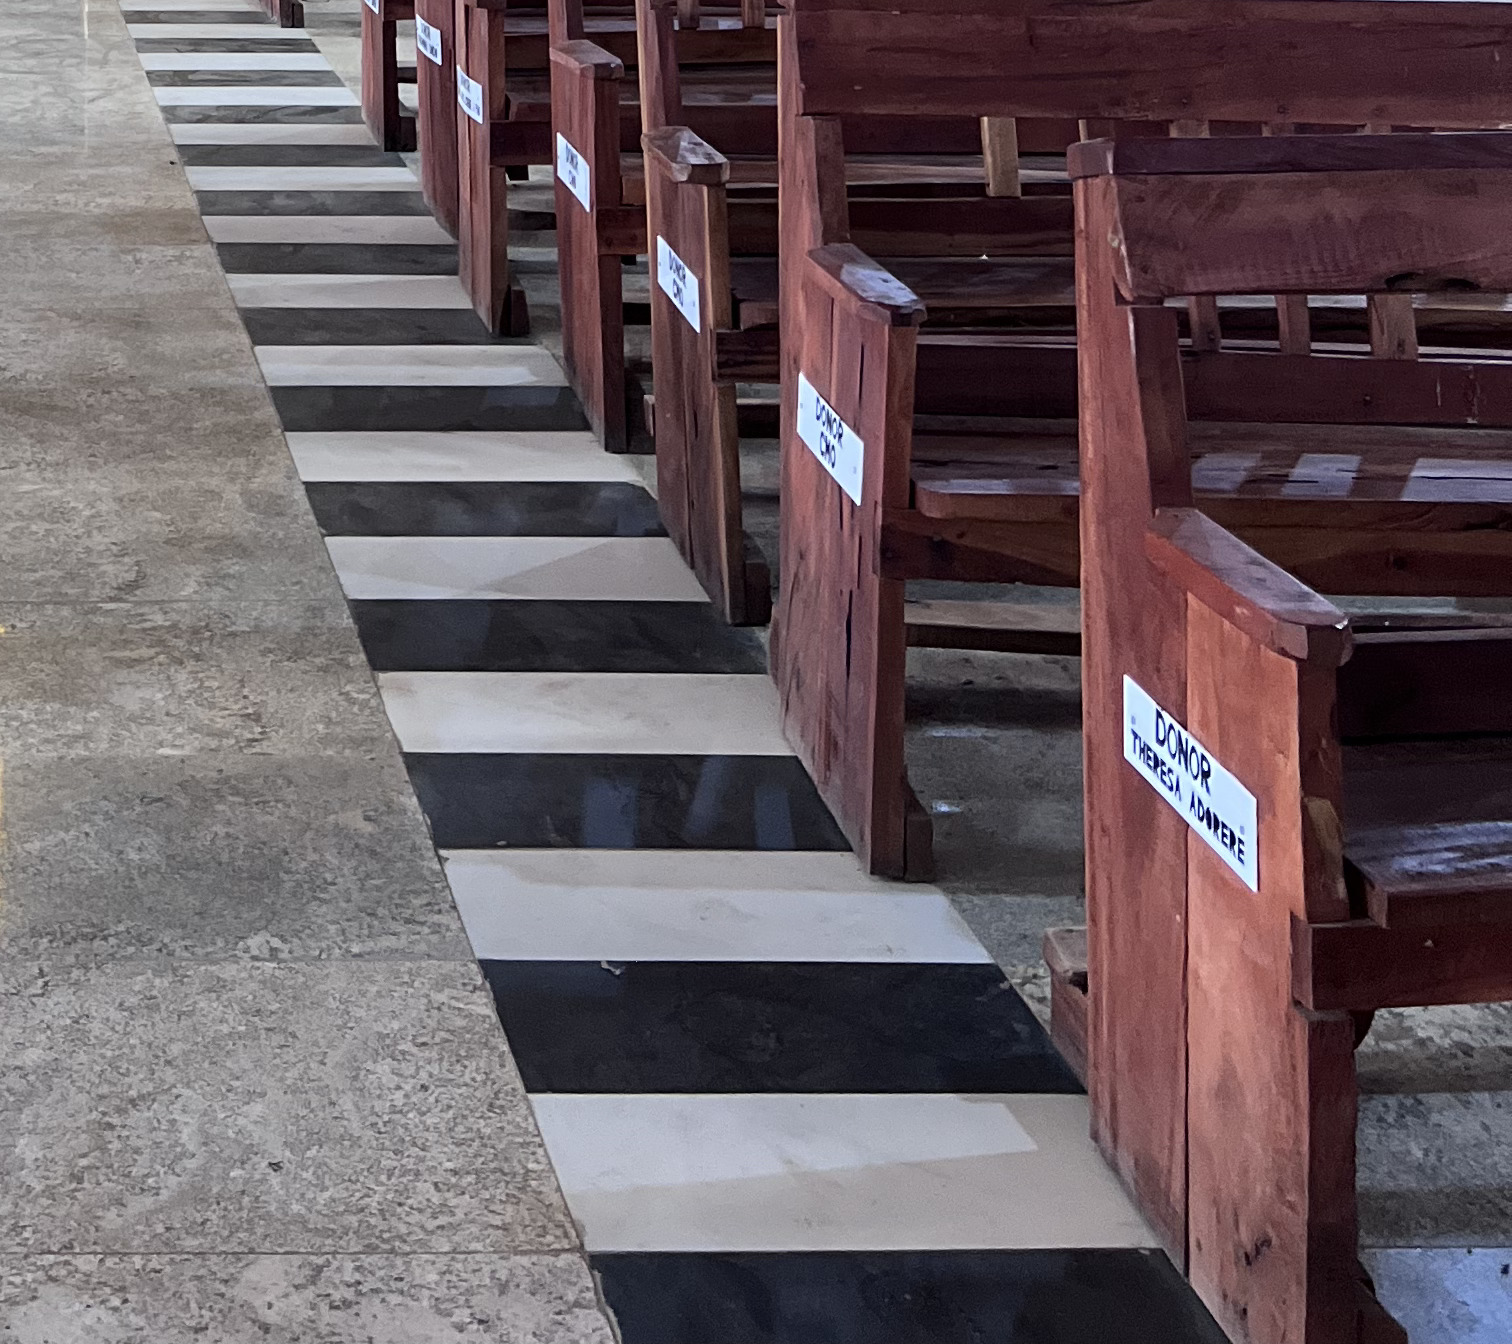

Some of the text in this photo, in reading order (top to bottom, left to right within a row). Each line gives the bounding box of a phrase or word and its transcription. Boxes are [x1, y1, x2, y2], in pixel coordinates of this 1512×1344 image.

[815, 396, 844, 449] DONOR
[1130, 728, 1182, 802] THERESA
[1155, 708, 1211, 796] DONOR
